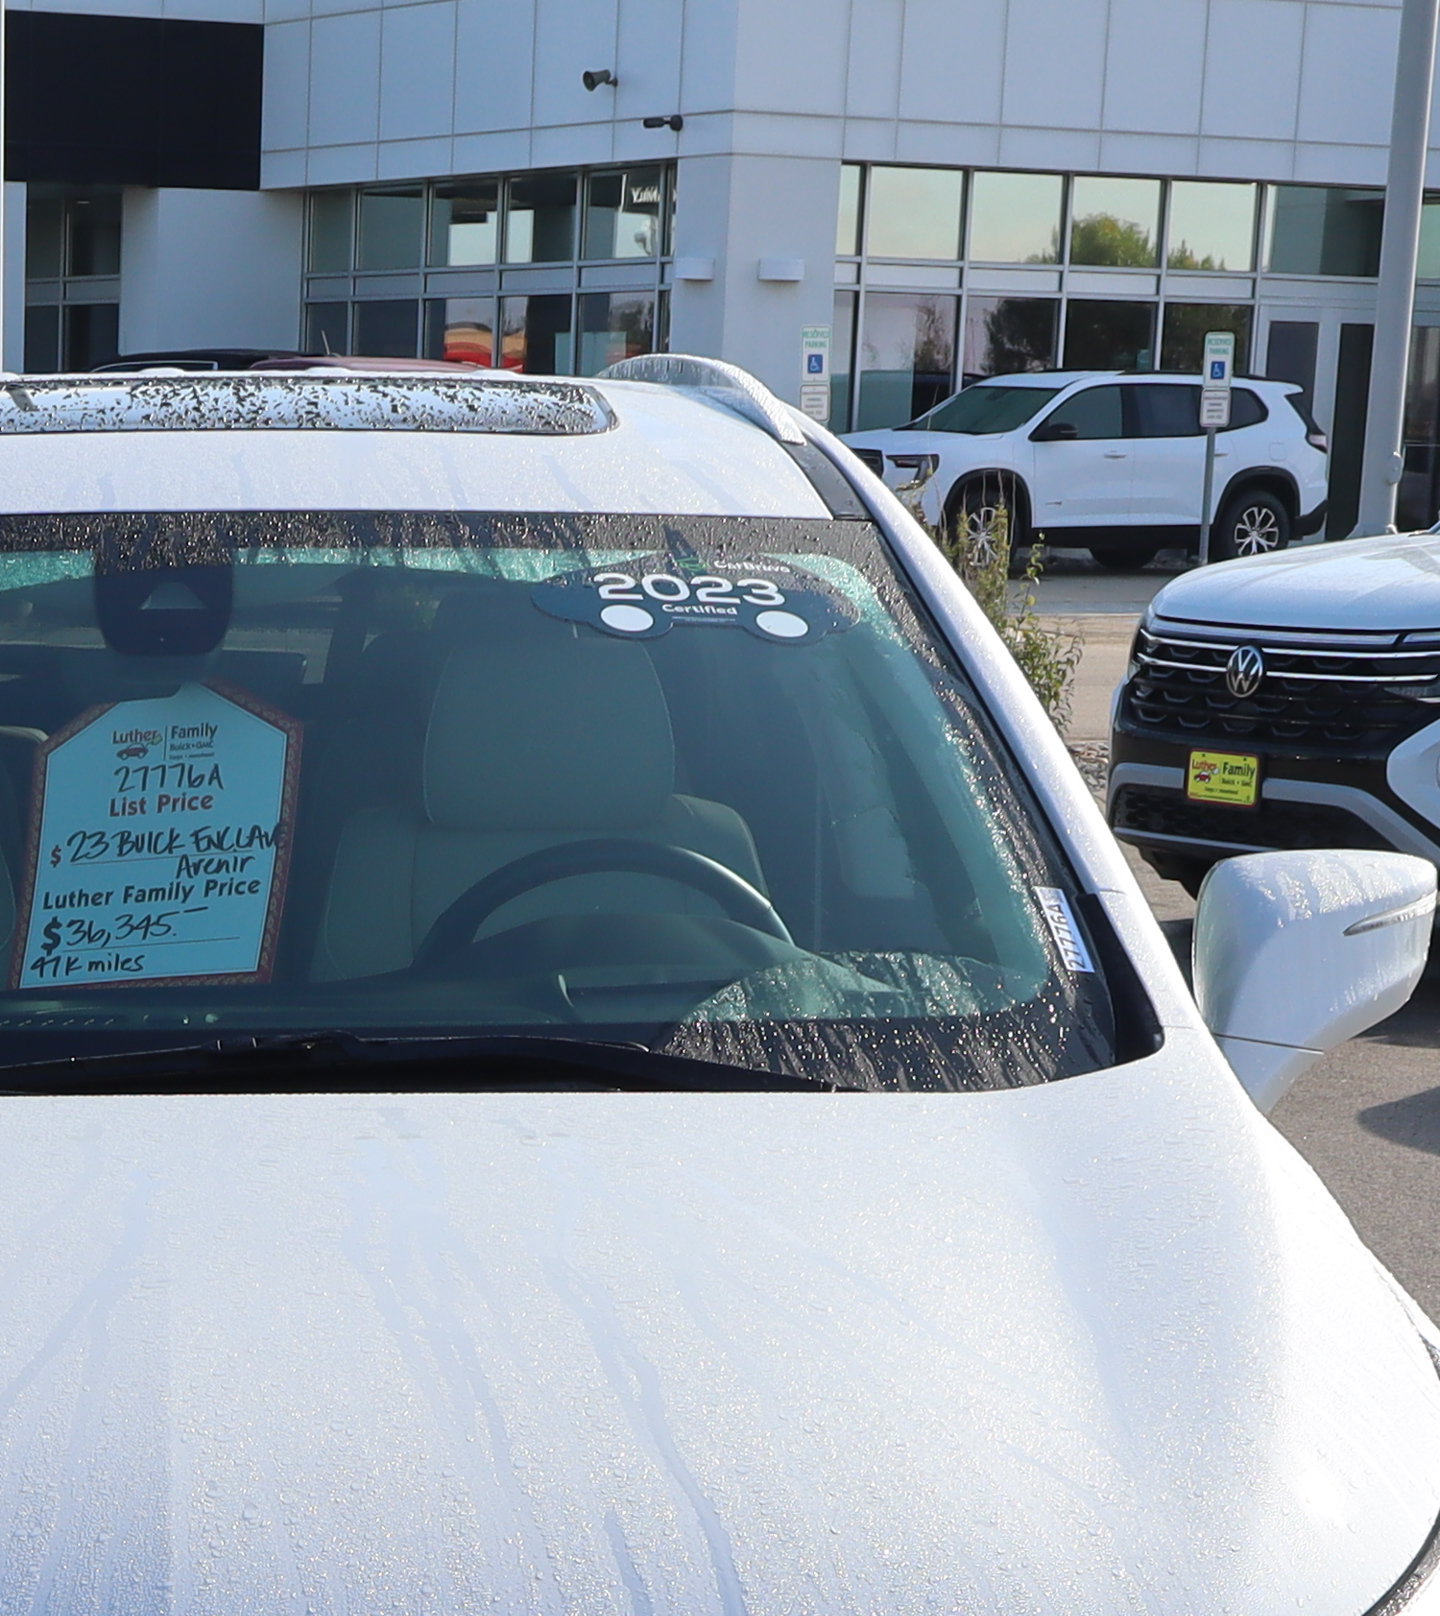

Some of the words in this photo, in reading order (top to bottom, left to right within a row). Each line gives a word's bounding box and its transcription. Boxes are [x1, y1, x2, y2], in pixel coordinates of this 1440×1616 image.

[593, 572, 786, 606] 2023
[662, 603, 737, 616] Certified
[112, 728, 159, 744] Luther
[171, 722, 218, 740] Family
[113, 762, 224, 793] 27776A
[1223, 761, 1255, 779] Family
[109, 796, 146, 817] List
[157, 792, 214, 814] Price
[49, 845, 62, 868] $
[66, 830, 110, 862] 23
[112, 828, 186, 856] BUICK
[43, 889, 114, 910] Luther
[122, 881, 195, 904] Family
[204, 878, 261, 898] Price
[1047, 904, 1087, 969] 27776A
[88, 953, 145, 972] miles
